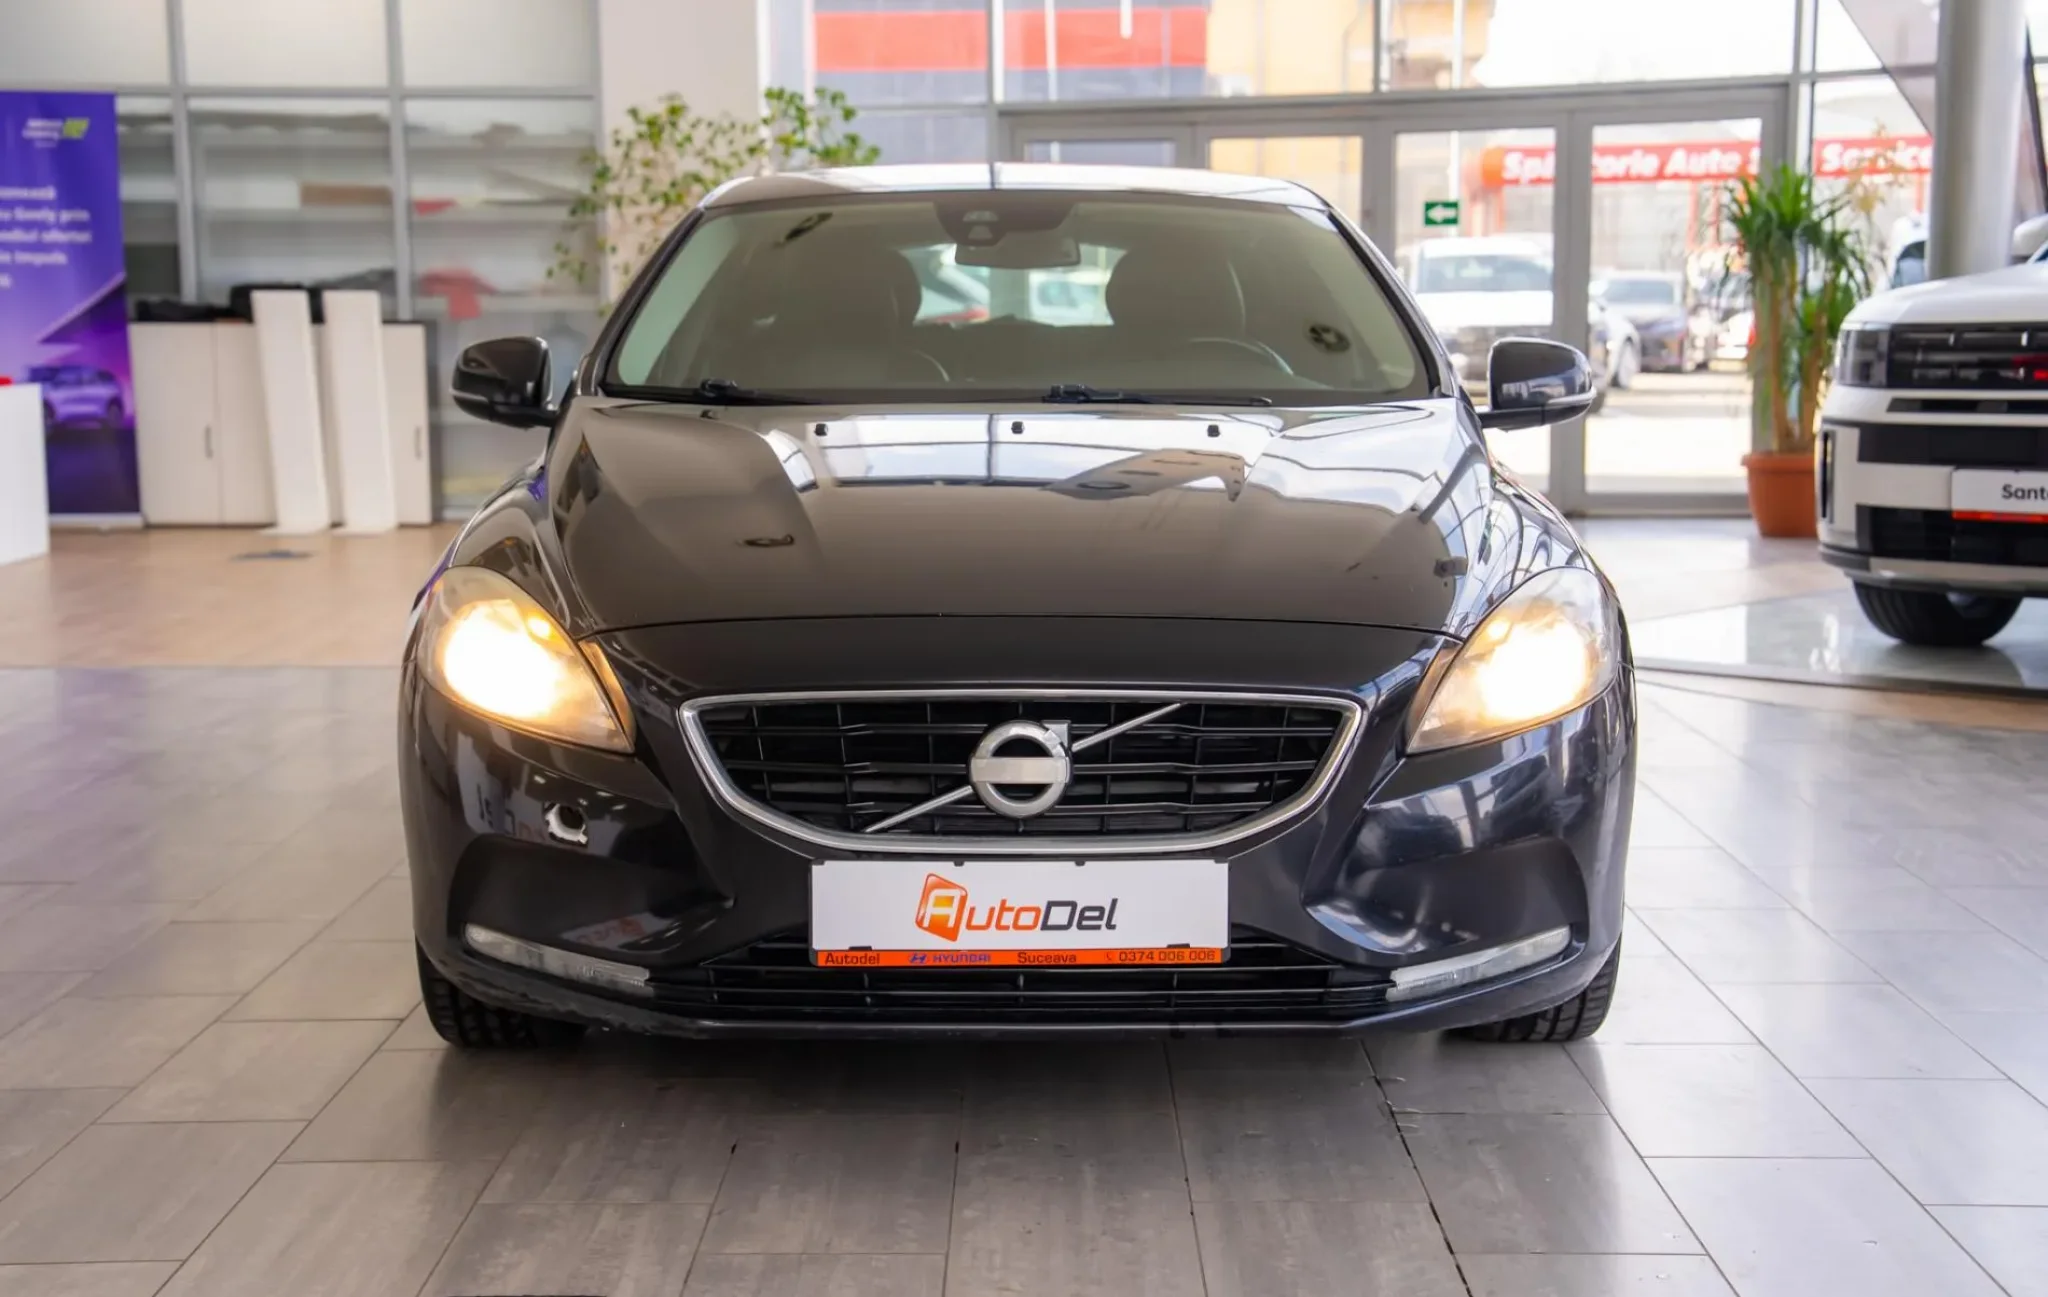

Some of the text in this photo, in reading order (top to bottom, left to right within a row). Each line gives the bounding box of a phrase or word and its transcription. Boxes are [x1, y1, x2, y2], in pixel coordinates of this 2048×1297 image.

[2001, 483, 2048, 501] Sant
[922, 886, 1119, 931] AutoDel
[824, 952, 881, 966] Autodel
[932, 953, 992, 964] HYUNDAI
[1017, 951, 1077, 964] Suceava
[1118, 950, 1154, 963] 0374
[1158, 950, 1186, 962] 006
